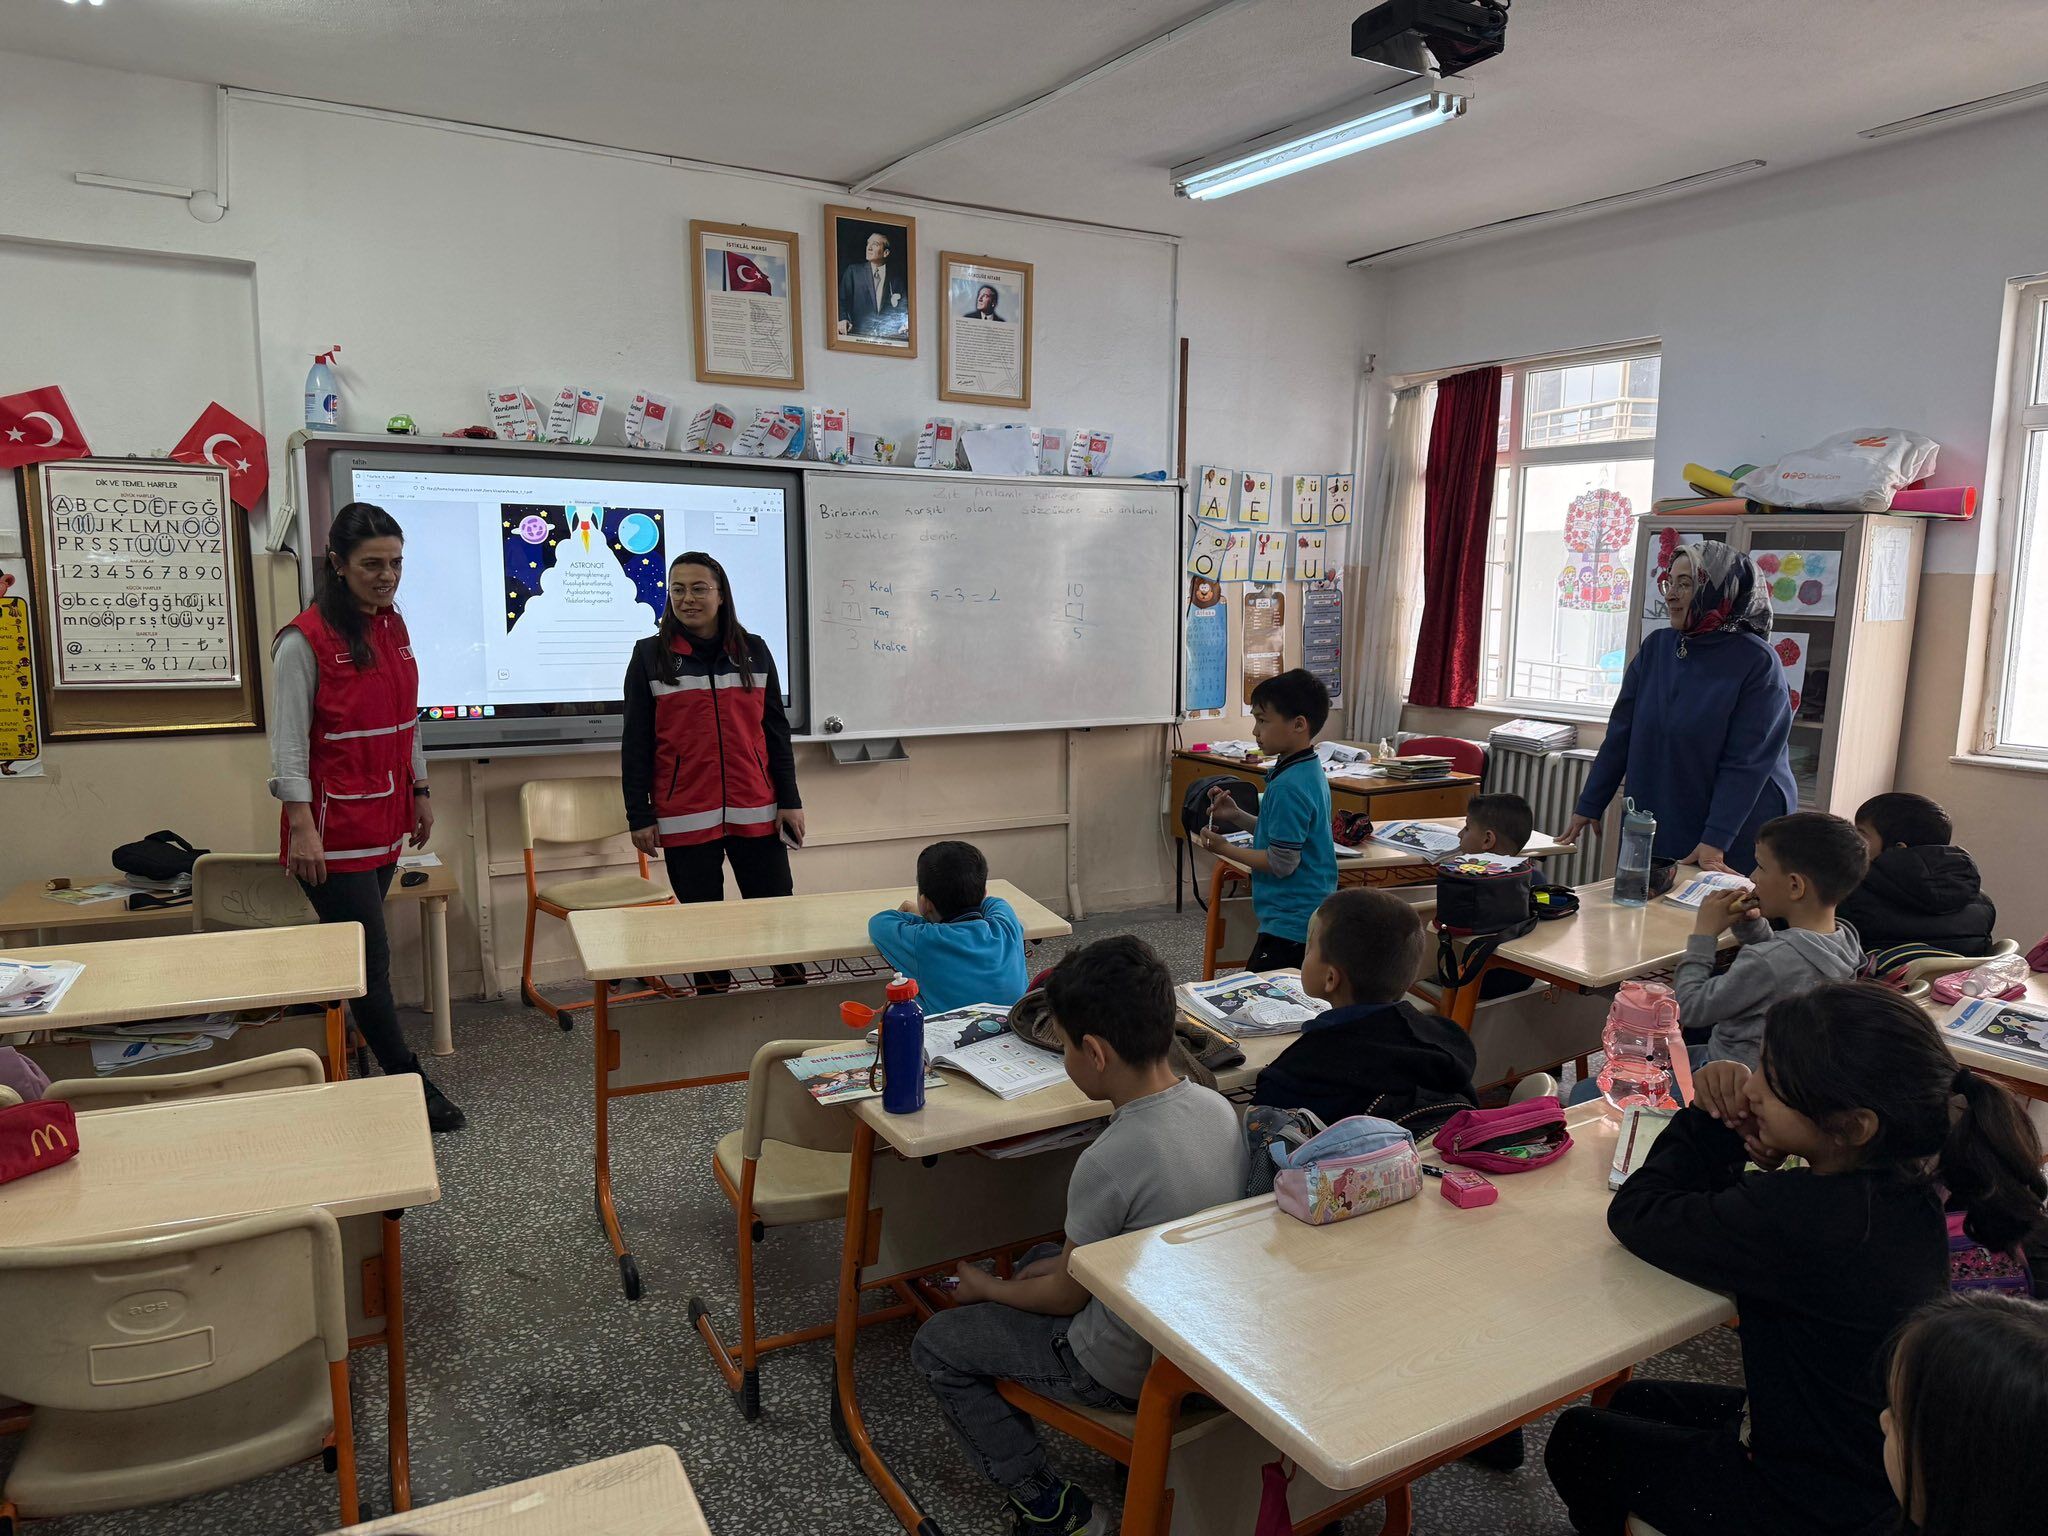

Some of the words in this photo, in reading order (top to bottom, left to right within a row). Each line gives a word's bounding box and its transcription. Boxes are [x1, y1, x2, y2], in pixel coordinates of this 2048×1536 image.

[122, 480, 145, 488] TEMEL
[147, 481, 178, 489] HARFLER
[1219, 477, 1227, 486] a
[1260, 481, 1266, 490] e
[1310, 480, 1317, 492] ü
[1342, 480, 1349, 492] ö
[56, 498, 70, 511] A
[76, 499, 86, 512] B
[94, 499, 108, 513] C
[114, 499, 128, 516] Ç
[134, 500, 146, 513] D
[154, 501, 164, 514] E
[169, 501, 178, 514] F
[182, 501, 197, 515] G
[202, 499, 218, 515] Ğ
[1205, 497, 1219, 518] A
[1250, 501, 1261, 522] E
[57, 518, 70, 531] H
[95, 519, 104, 532] J
[112, 519, 123, 532] K
[130, 519, 140, 533] L
[144, 520, 160, 533] M
[167, 520, 178, 534] N
[184, 520, 199, 534] O
[204, 517, 219, 535] Ö
[58, 537, 67, 550] P
[75, 537, 83, 550] R
[92, 537, 101, 550] S
[109, 538, 119, 554] Ş
[123, 538, 133, 551] T
[140, 539, 151, 552] U
[160, 535, 170, 552] Ü
[178, 539, 190, 552] V
[196, 540, 207, 553] Y
[210, 540, 221, 553] Z
[1314, 540, 1321, 548] u
[570, 561, 605, 569] ASTRONOT
[1195, 554, 1213, 575] O
[1304, 559, 1317, 578] U
[72, 565, 83, 579] 2
[90, 565, 100, 579] 3
[107, 565, 118, 579] 4
[125, 565, 135, 579] 5
[143, 566, 153, 579] 6
[162, 566, 171, 579] 7
[179, 566, 188, 579] 8
[196, 566, 206, 580] 9
[211, 566, 222, 580] 0
[841, 579, 857, 596] 5
[869, 580, 893, 596] Kral
[1067, 583, 1084, 597] 10
[870, 606, 889, 618] Taç
